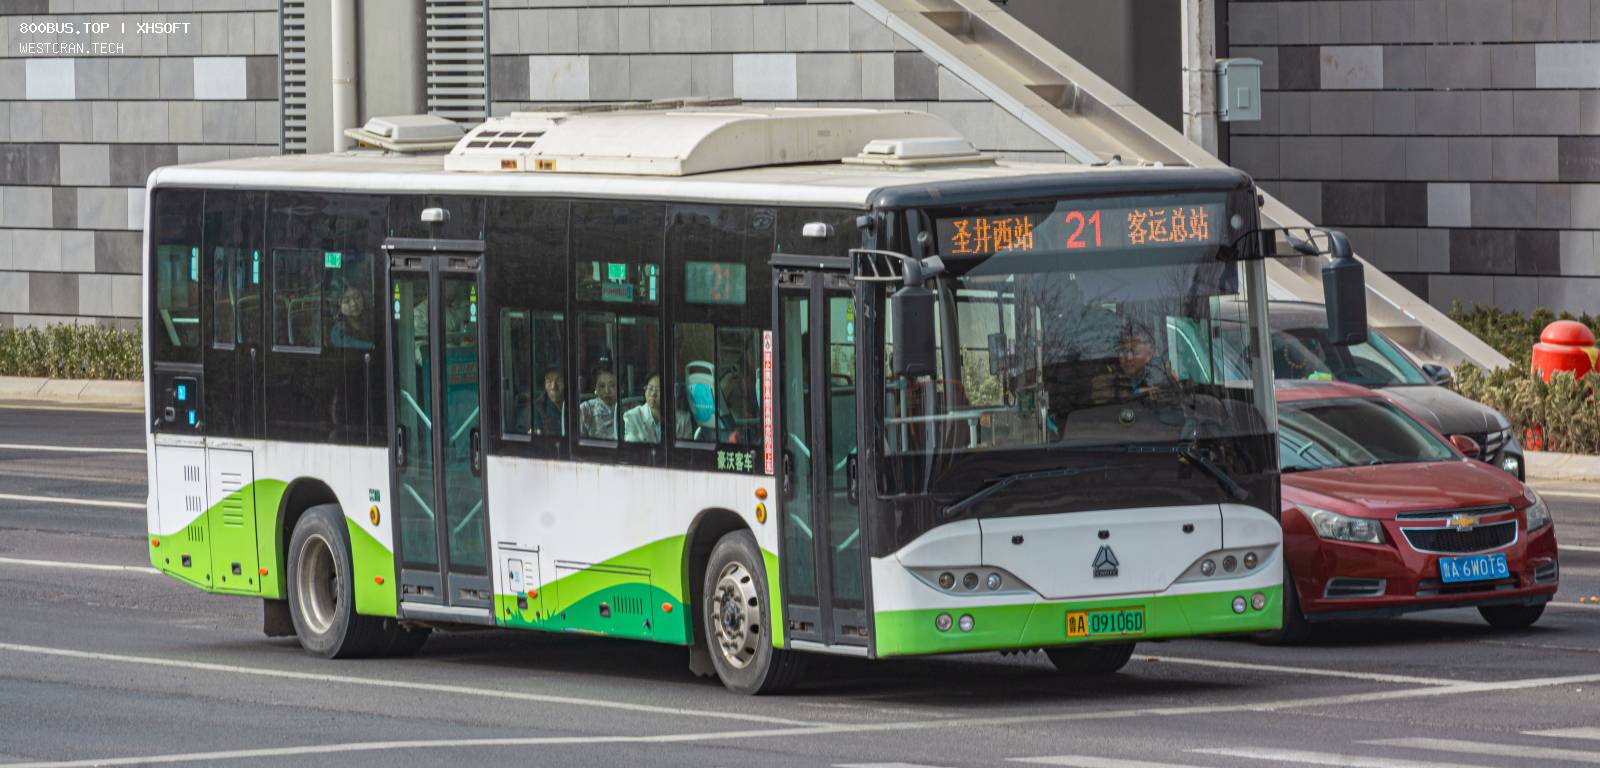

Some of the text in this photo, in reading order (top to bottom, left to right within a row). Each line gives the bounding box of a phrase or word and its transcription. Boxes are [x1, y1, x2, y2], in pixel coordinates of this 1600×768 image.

[951, 215, 1034, 255] 圣井西站
[1065, 209, 1102, 249] 21
[1127, 206, 1209, 245] 客运总站
[717, 450, 753, 472] 豪沃客车
